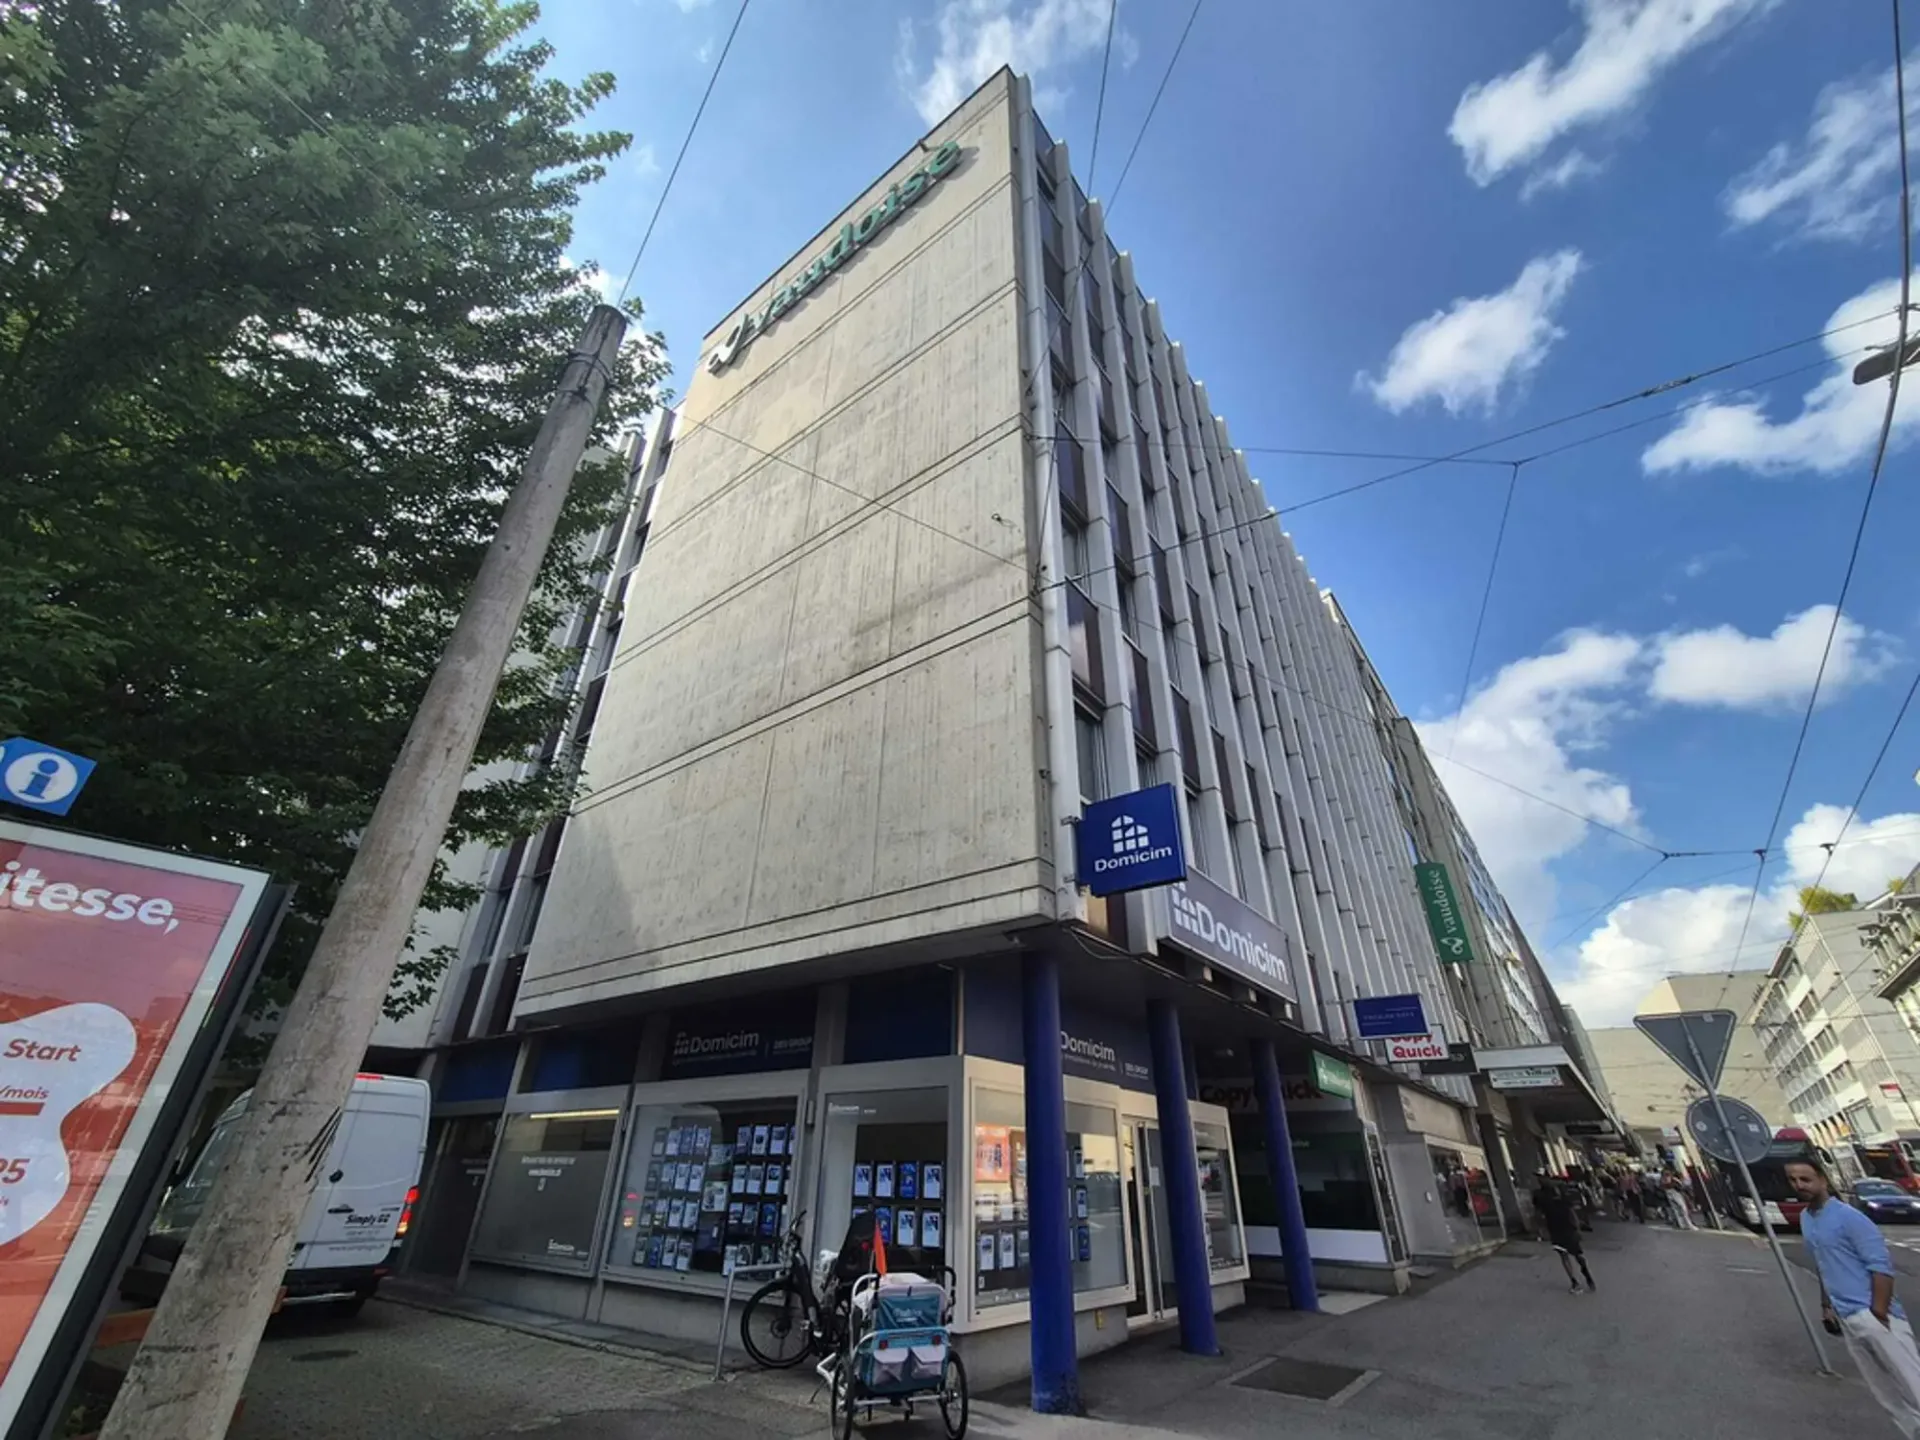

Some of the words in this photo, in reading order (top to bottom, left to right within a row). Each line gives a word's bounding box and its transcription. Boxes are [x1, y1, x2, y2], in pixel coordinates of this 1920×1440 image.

[747, 140, 962, 334] vaudoise
[1095, 846, 1172, 873] Domicim
[0, 861, 179, 936] itesse,
[1428, 869, 1457, 934] vaudoise
[1198, 901, 1289, 985] Domicim
[4, 1038, 81, 1062] Start
[691, 1030, 759, 1053] Domicim
[1060, 1030, 1116, 1062] Domicim
[1393, 1045, 1443, 1058] Quick
[345, 1214, 378, 1225] Simply
